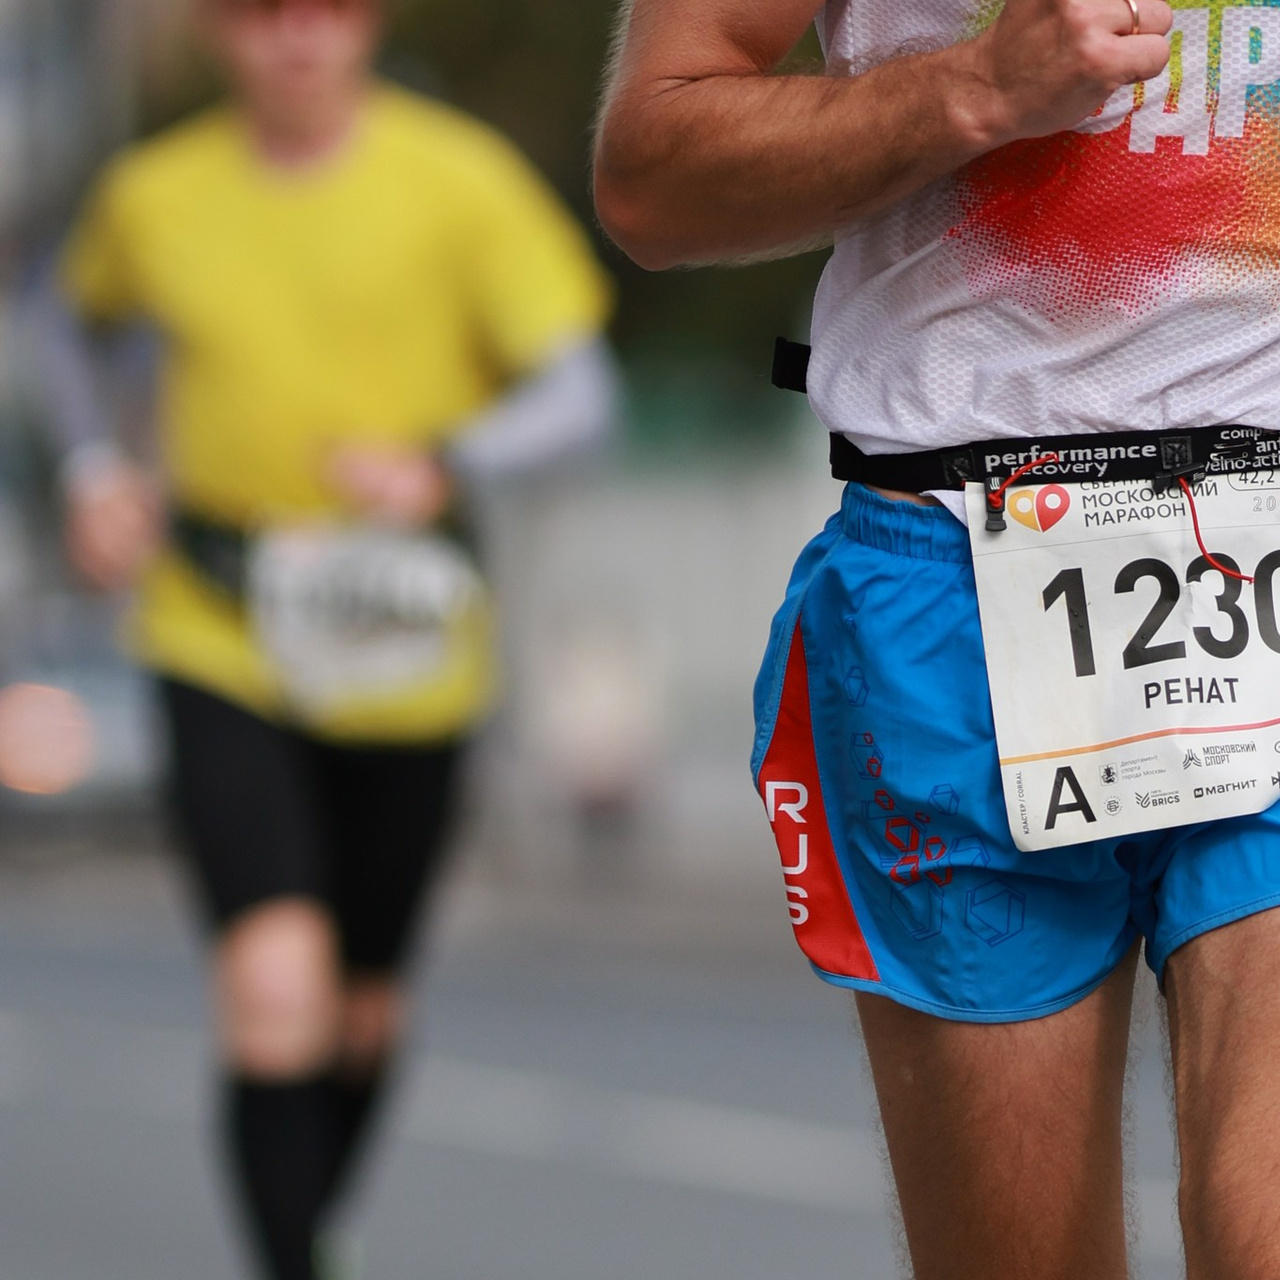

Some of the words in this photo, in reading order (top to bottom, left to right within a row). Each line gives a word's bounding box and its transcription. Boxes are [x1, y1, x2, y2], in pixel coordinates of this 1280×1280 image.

[985, 445, 1158, 473] performance
[1238, 470, 1275, 486] 42,2
[1084, 502, 1187, 528] МАРАФОН
[1143, 677, 1240, 709] РЕНАТ
[1202, 741, 1257, 755] МОСКОВСКИЙ
[1204, 754, 1231, 766] СПОРТ
[1151, 795, 1181, 807] BRICS
